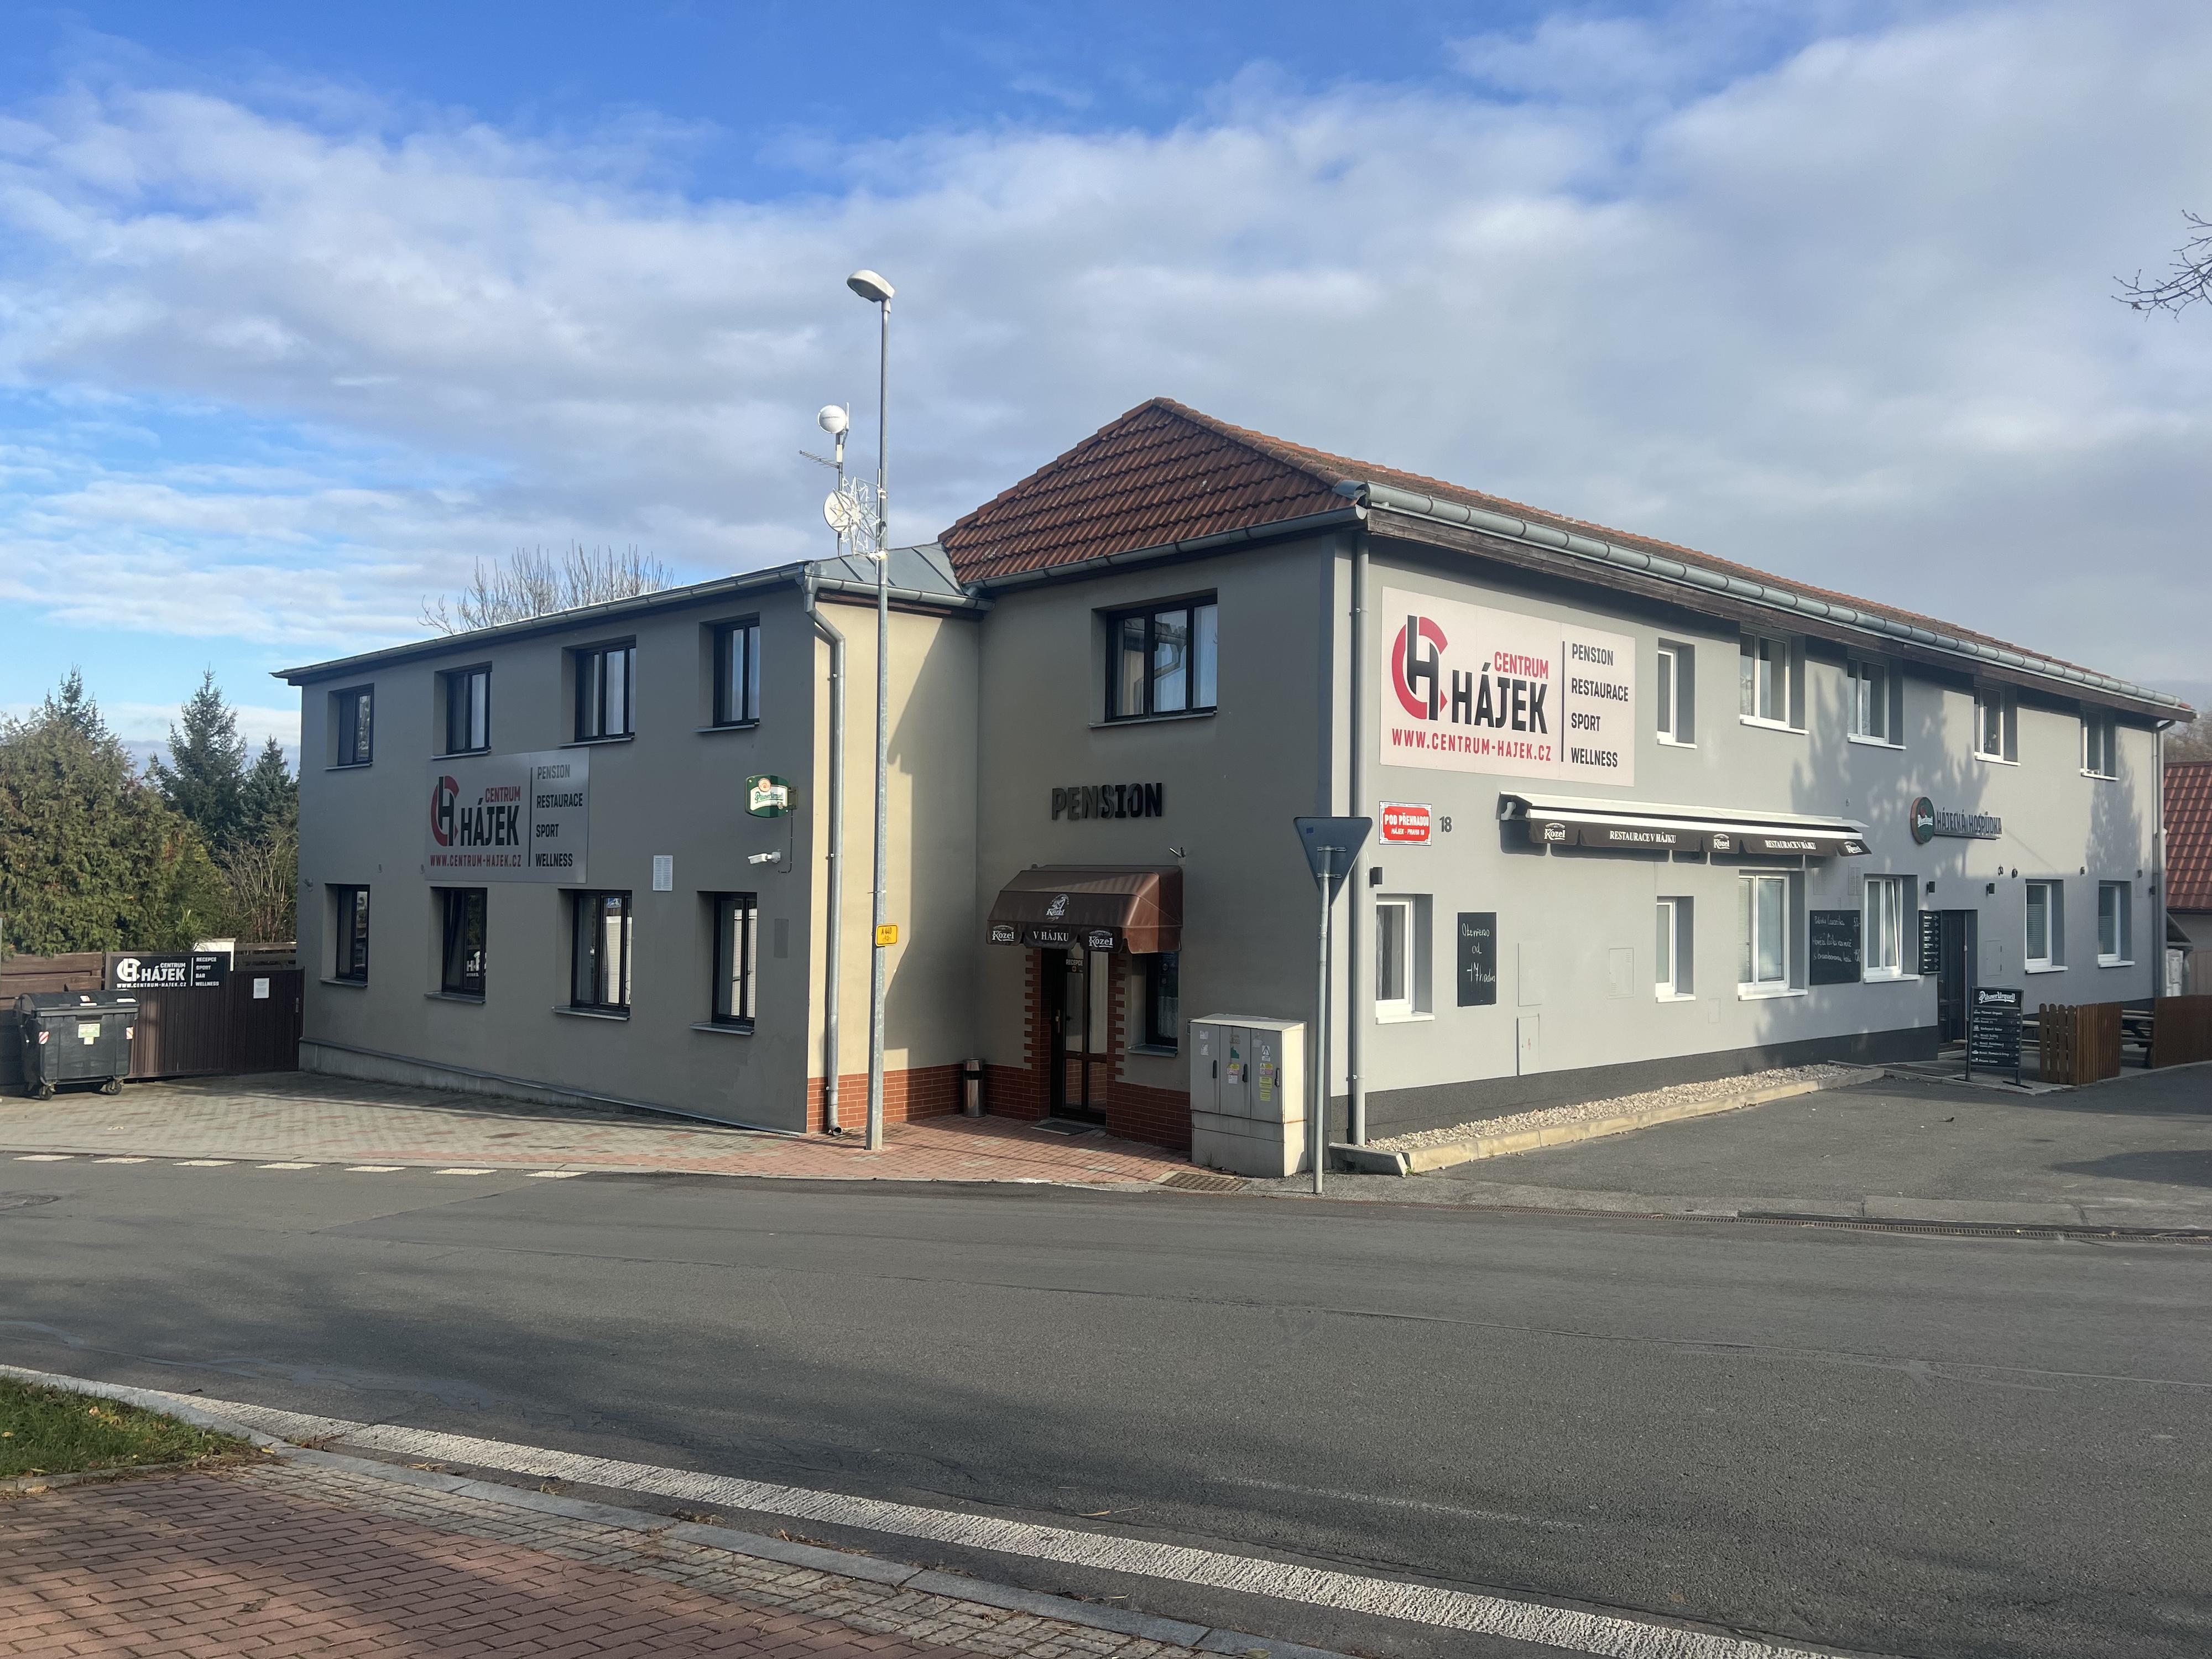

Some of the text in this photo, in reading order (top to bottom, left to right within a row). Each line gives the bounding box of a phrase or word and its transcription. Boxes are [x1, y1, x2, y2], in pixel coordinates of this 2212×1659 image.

[1572, 643, 1613, 666] PENSION
[1494, 651, 1548, 679] CENTRUM
[1572, 677, 1629, 702] RESTAURACE
[1452, 662, 1548, 734] HÁJEK
[1571, 712, 1600, 732] SPORT
[1392, 728, 1551, 761] WWW.CENTRUM-HAJEK.CZ
[1571, 747, 1618, 768] WELLNESS
[537, 764, 570, 780] PENSION
[485, 786, 520, 802] CENTRUM
[536, 793, 583, 808] RESTAURACE
[1052, 782, 1162, 820] PENSION
[460, 797, 520, 846] HÁJEK
[1385, 812, 1430, 826] POD PŘEHRADOU
[1439, 816, 1452, 832] 18
[1937, 807, 2002, 834] HÁJECKÁ HOSPŮDKA
[536, 823, 559, 837] SPORT
[1544, 828, 1566, 841] Kozel
[1610, 830, 1676, 844] RESTAURACE V HÁJKU
[1714, 838, 1730, 849] Kozel
[1765, 839, 1797, 849] RESTAURACE
[1845, 844, 1863, 854] Kozel
[430, 854, 521, 867] WWW.CENTRUM-HAJEK.CZ
[535, 853, 573, 867] WELLNESS
[992, 930, 1014, 941] Kozel
[1034, 930, 1069, 942] V HÁJKU
[1089, 936, 1113, 947] Kozel
[1472, 942, 1482, 954] od
[142, 966, 185, 981] HÁJEK
[1979, 990, 2016, 1004] Pilsner Urquell
